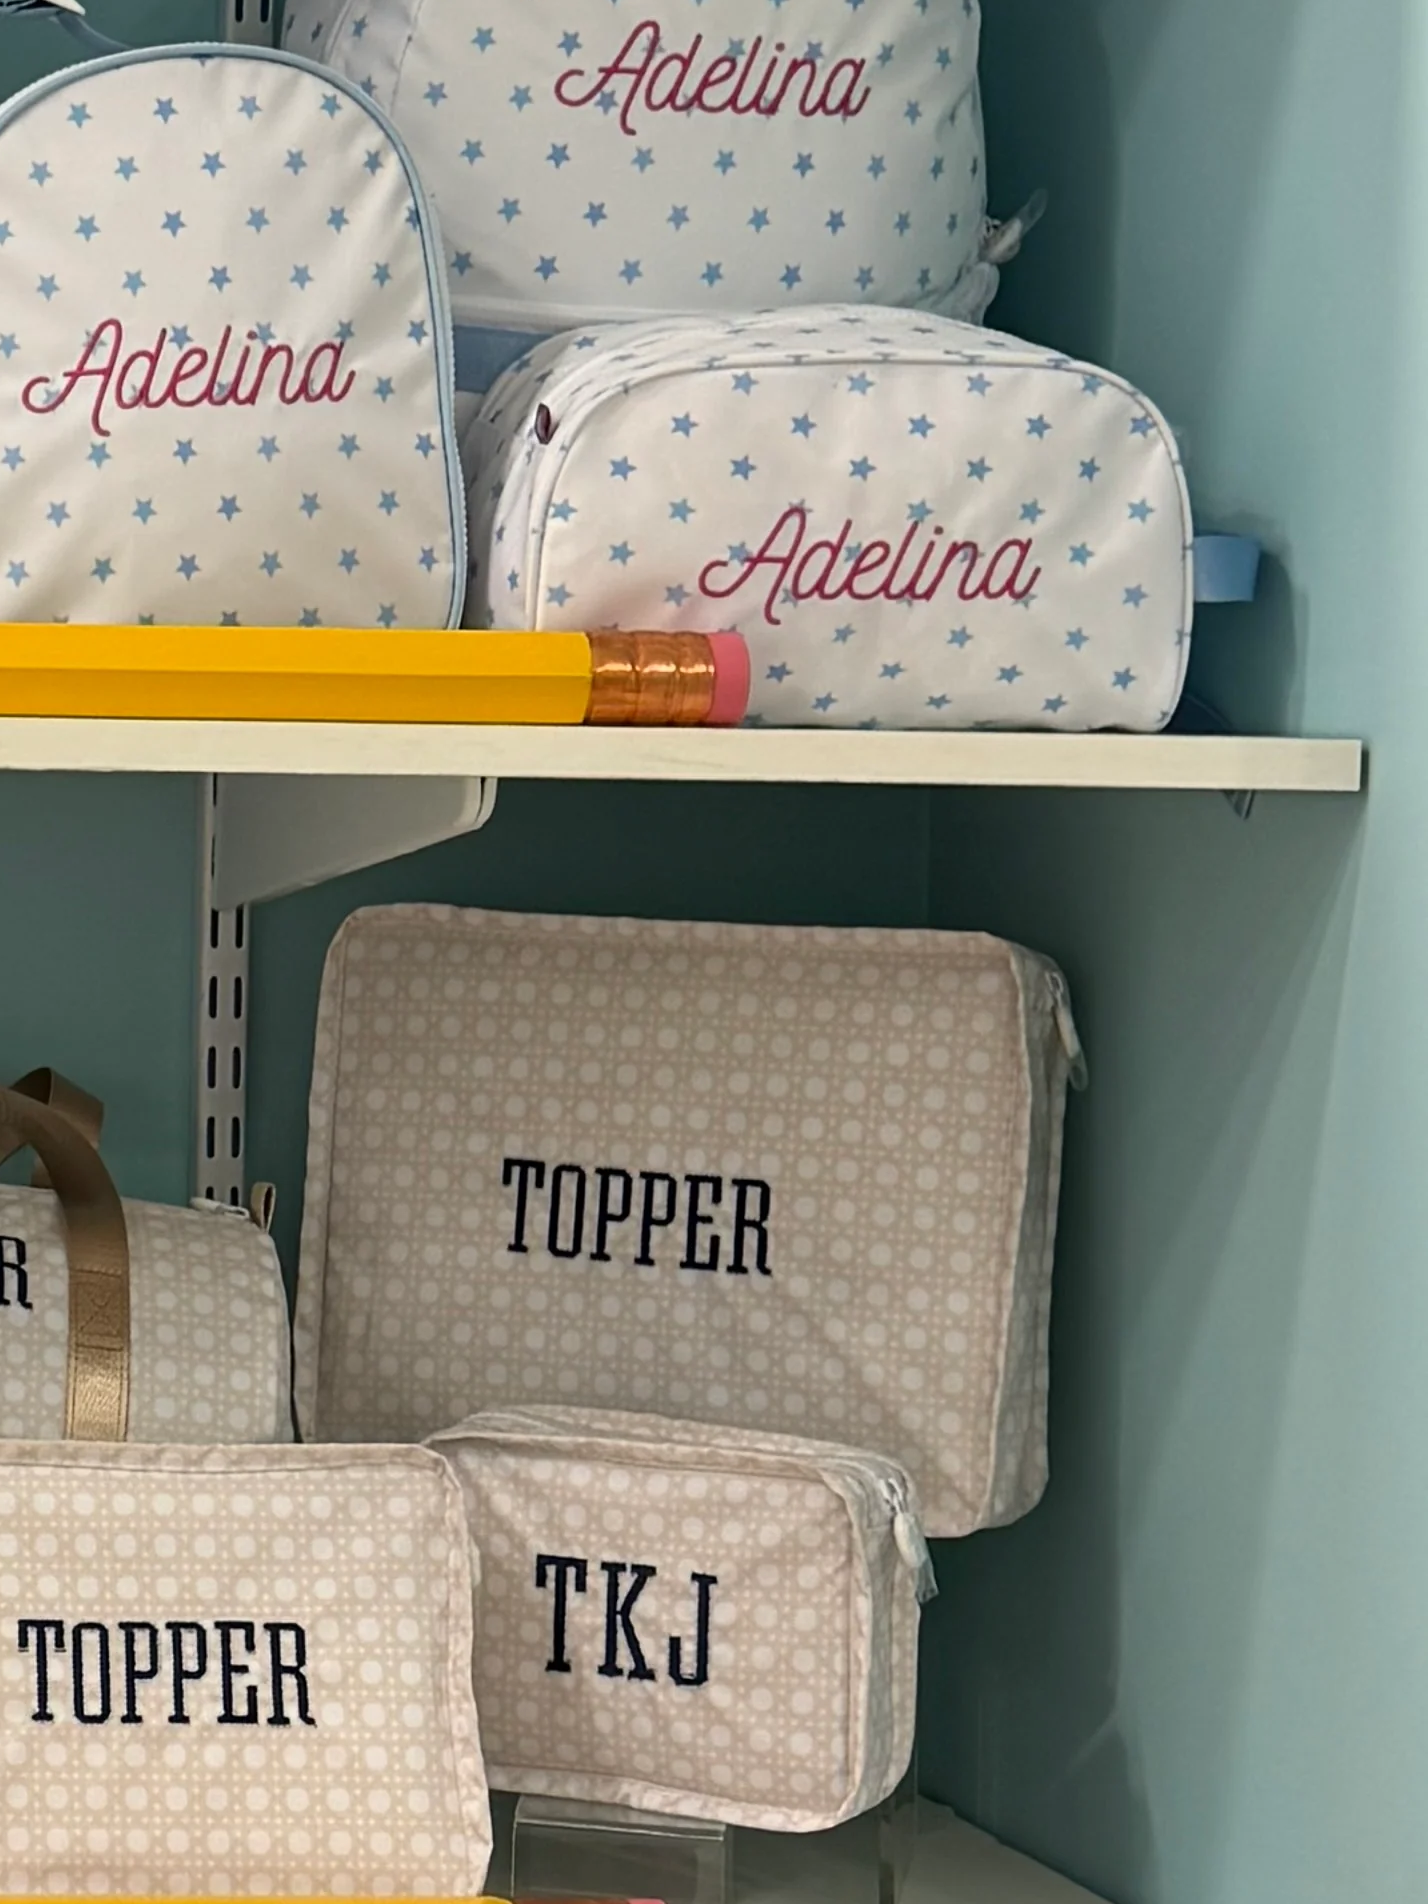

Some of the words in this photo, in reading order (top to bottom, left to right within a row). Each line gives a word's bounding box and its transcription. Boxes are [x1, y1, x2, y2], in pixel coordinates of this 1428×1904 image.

[553, 20, 872, 136] Adelina
[20, 319, 356, 438] Adelina
[697, 507, 1042, 626] Adelina
[501, 1157, 776, 1280] TOPPER
[17, 1617, 319, 1730] TOPPER
[535, 1552, 719, 1688] TKJ
